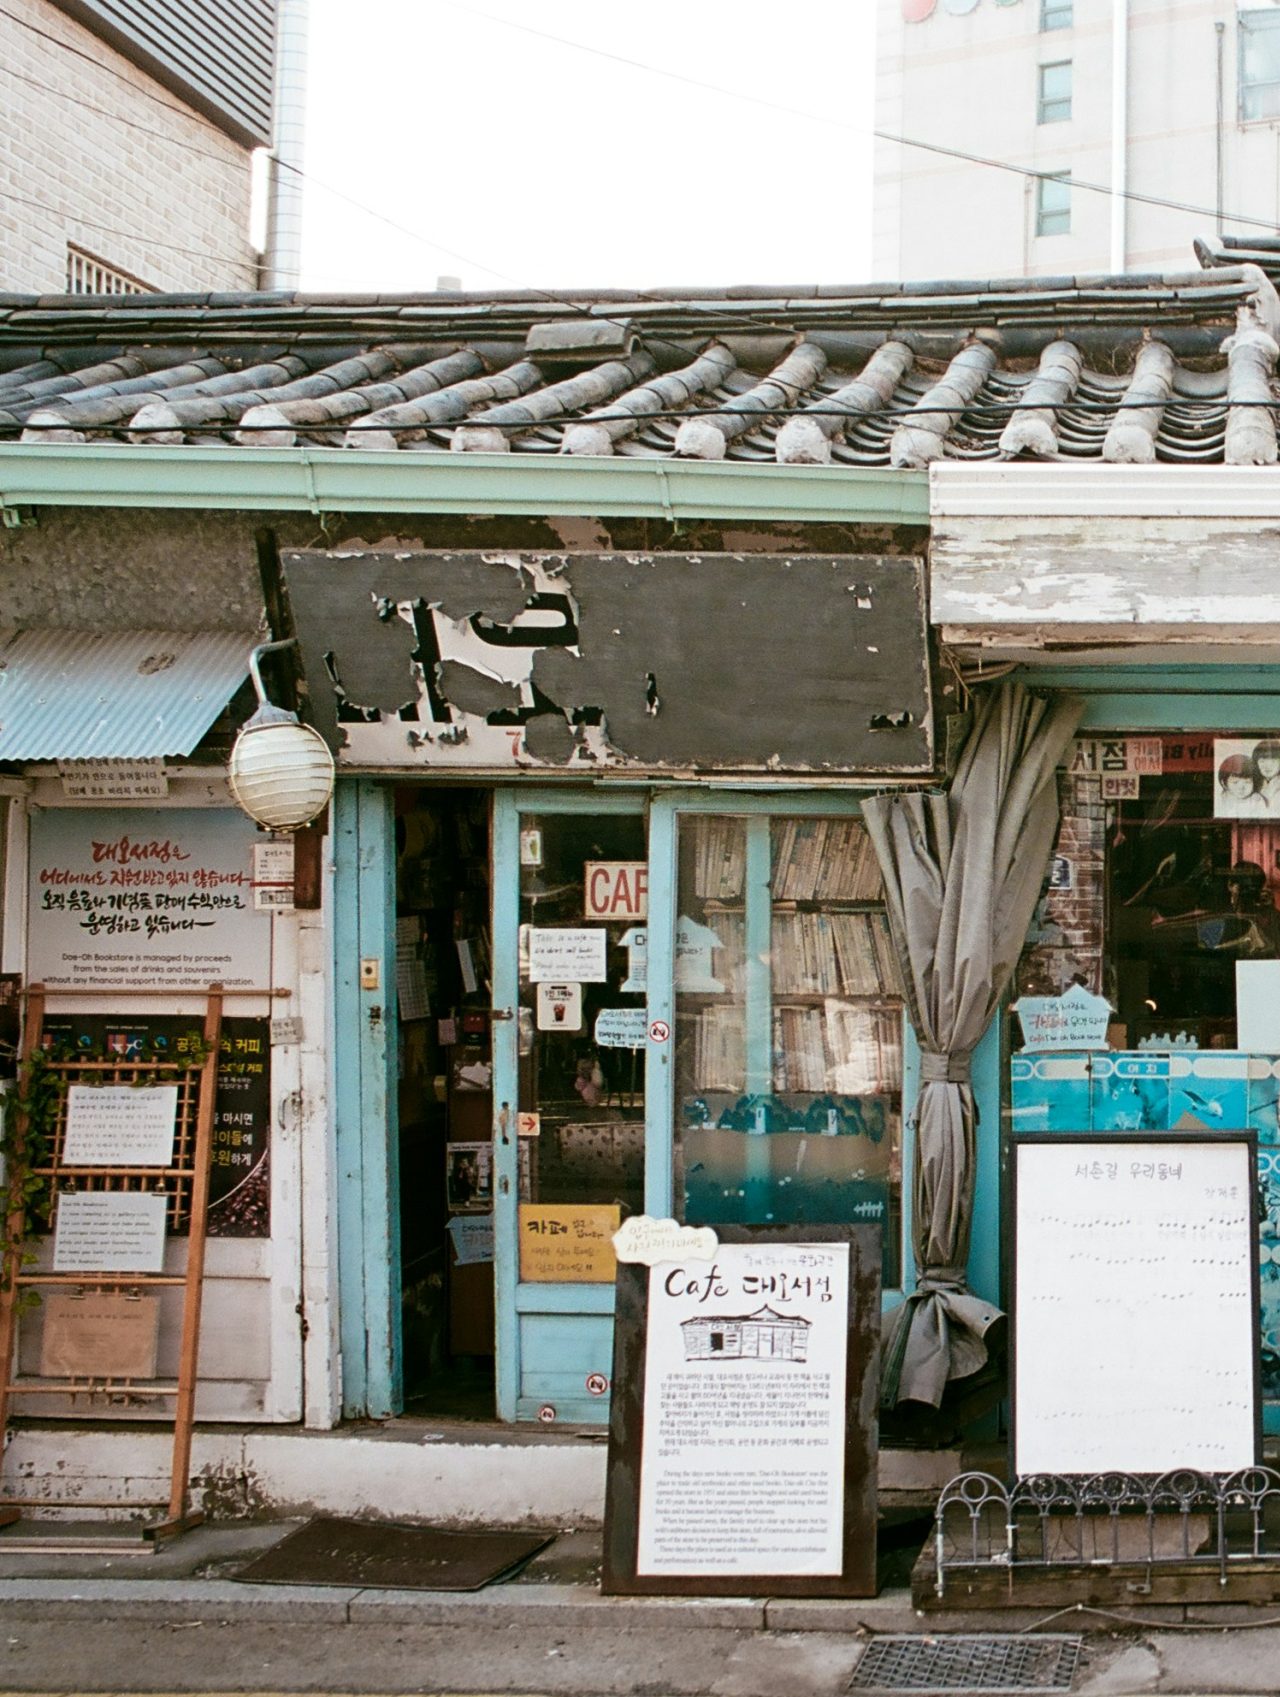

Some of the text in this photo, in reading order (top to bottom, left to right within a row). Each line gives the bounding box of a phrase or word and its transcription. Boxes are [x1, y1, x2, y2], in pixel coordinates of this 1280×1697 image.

[1072, 742, 1127, 771] 서점
[92, 836, 190, 864] 대오서점은
[40, 867, 107, 885] 어디에서도
[193, 867, 249, 888] 않습니다
[41, 889, 246, 913] 오직 음료와 기념품 판매 수익만으로
[80, 914, 216, 940] 운영하고 있습니다
[62, 953, 232, 965] Dae-Oh Bookstore is managed by proceeds
[73, 964, 221, 974] from the sales of drinks and souvenirs
[43, 975, 71, 984] without
[73, 976, 88, 985] any
[89, 976, 123, 985] financial
[124, 976, 156, 986] support
[158, 976, 178, 985] from
[180, 976, 201, 985] other
[236, 1038, 261, 1053] 커피
[223, 1113, 253, 1126] 마시면
[1075, 1162, 1183, 1180] 서촌길 우리동네
[527, 1220, 568, 1235] 카페
[742, 1273, 833, 1302] 대오서점
